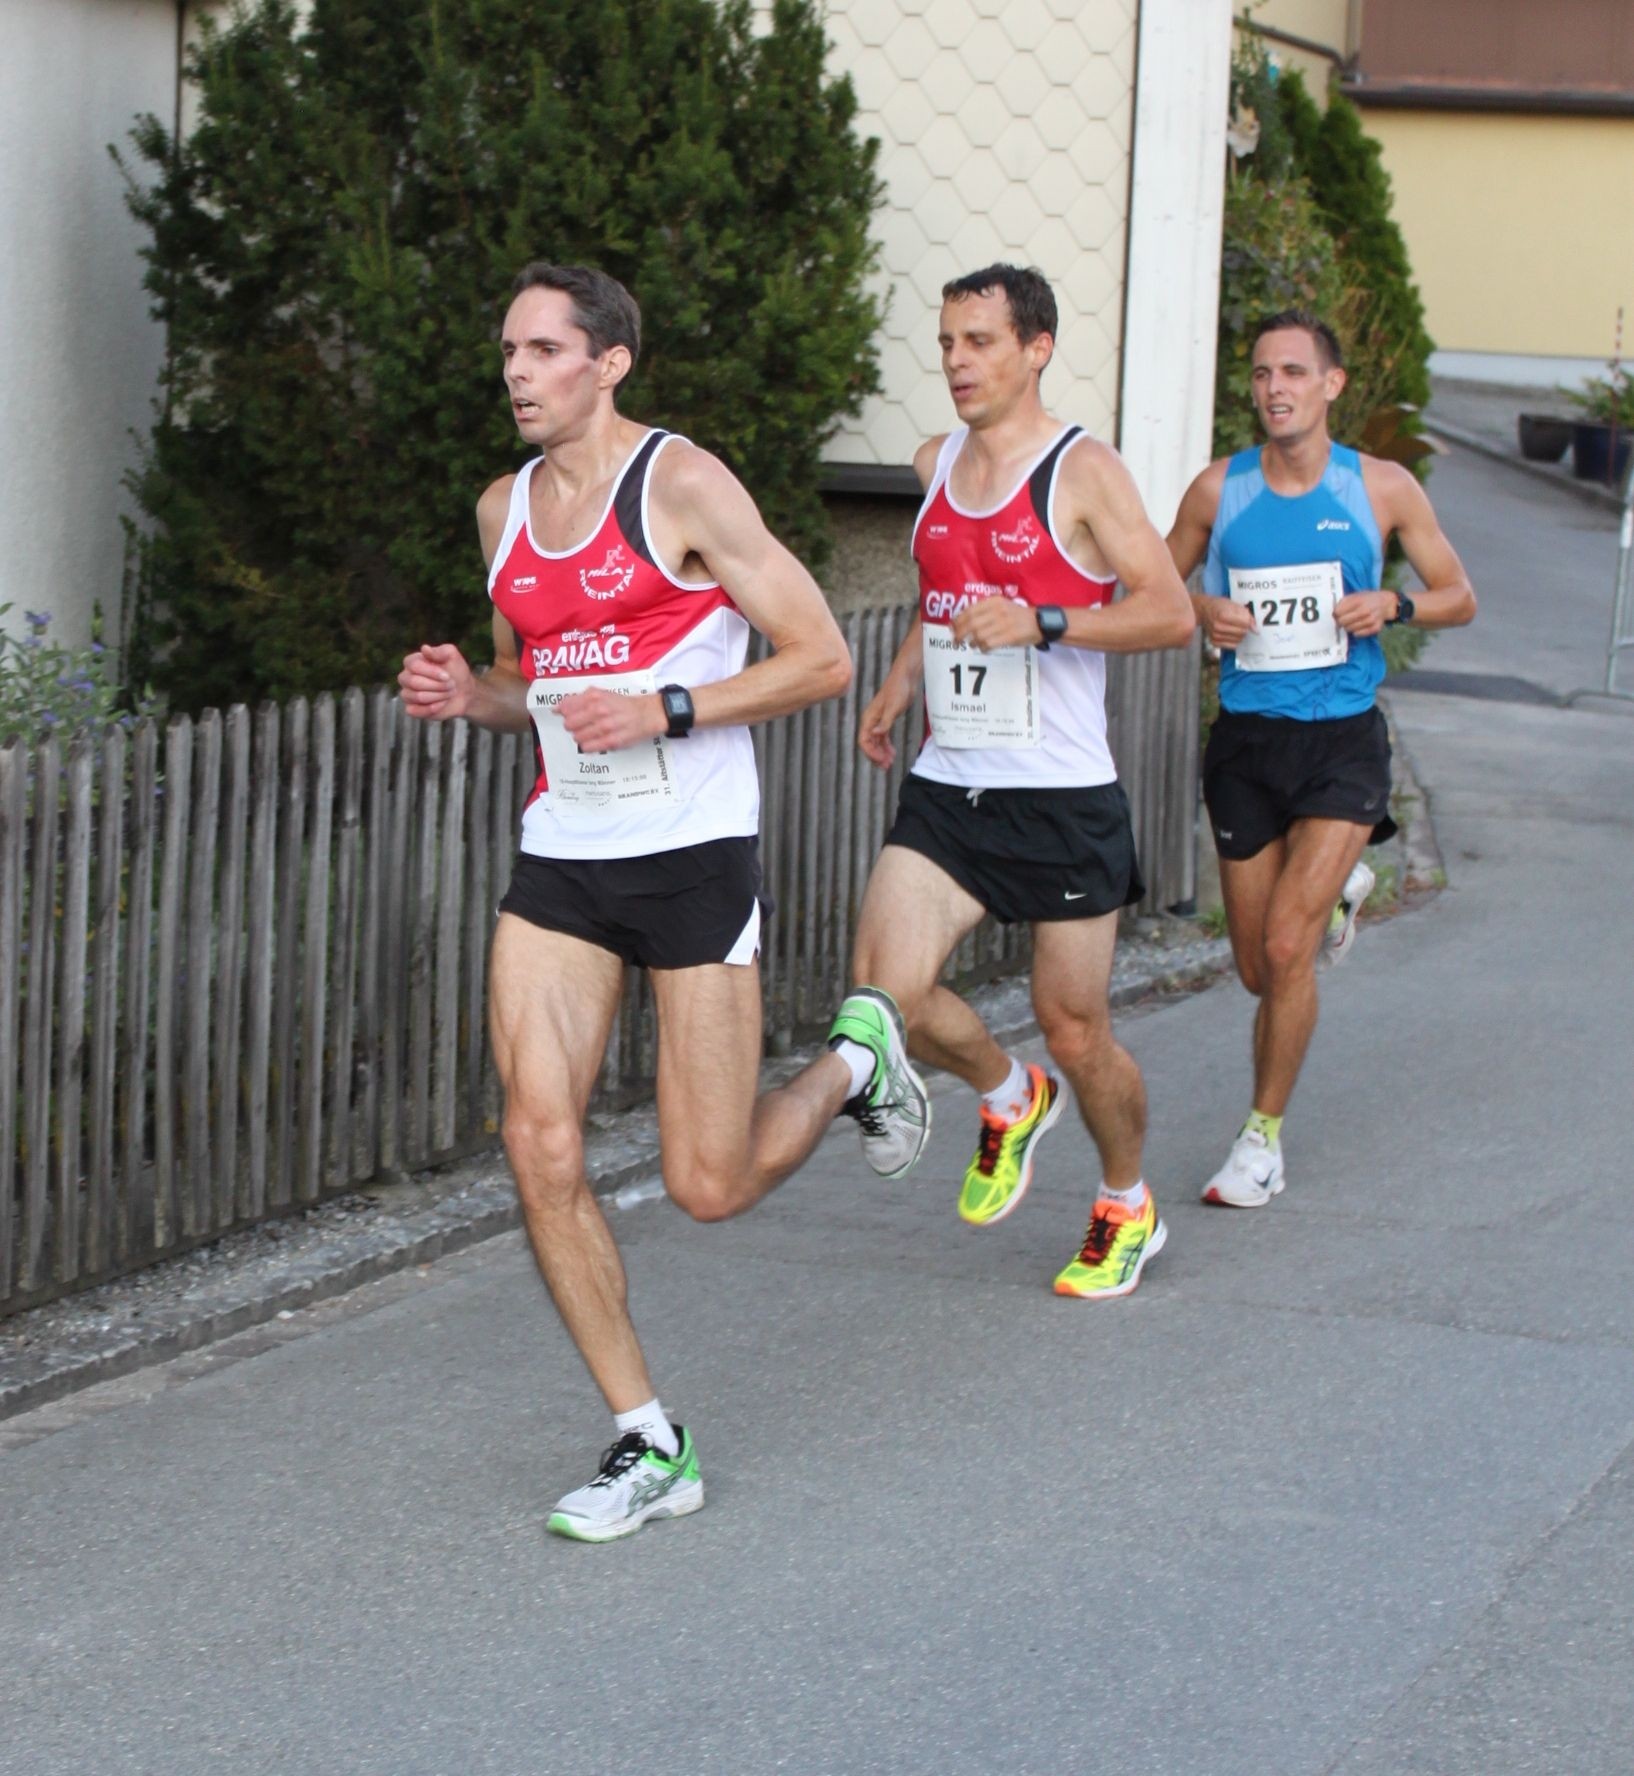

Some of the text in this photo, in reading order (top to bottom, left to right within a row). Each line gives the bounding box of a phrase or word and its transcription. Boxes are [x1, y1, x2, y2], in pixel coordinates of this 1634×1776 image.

[579, 563, 635, 600] RHEINTAL
[1237, 580, 1278, 591] MIGROS
[949, 663, 988, 697] 17
[951, 702, 987, 713] Ismael
[579, 762, 610, 774] Zoltan
